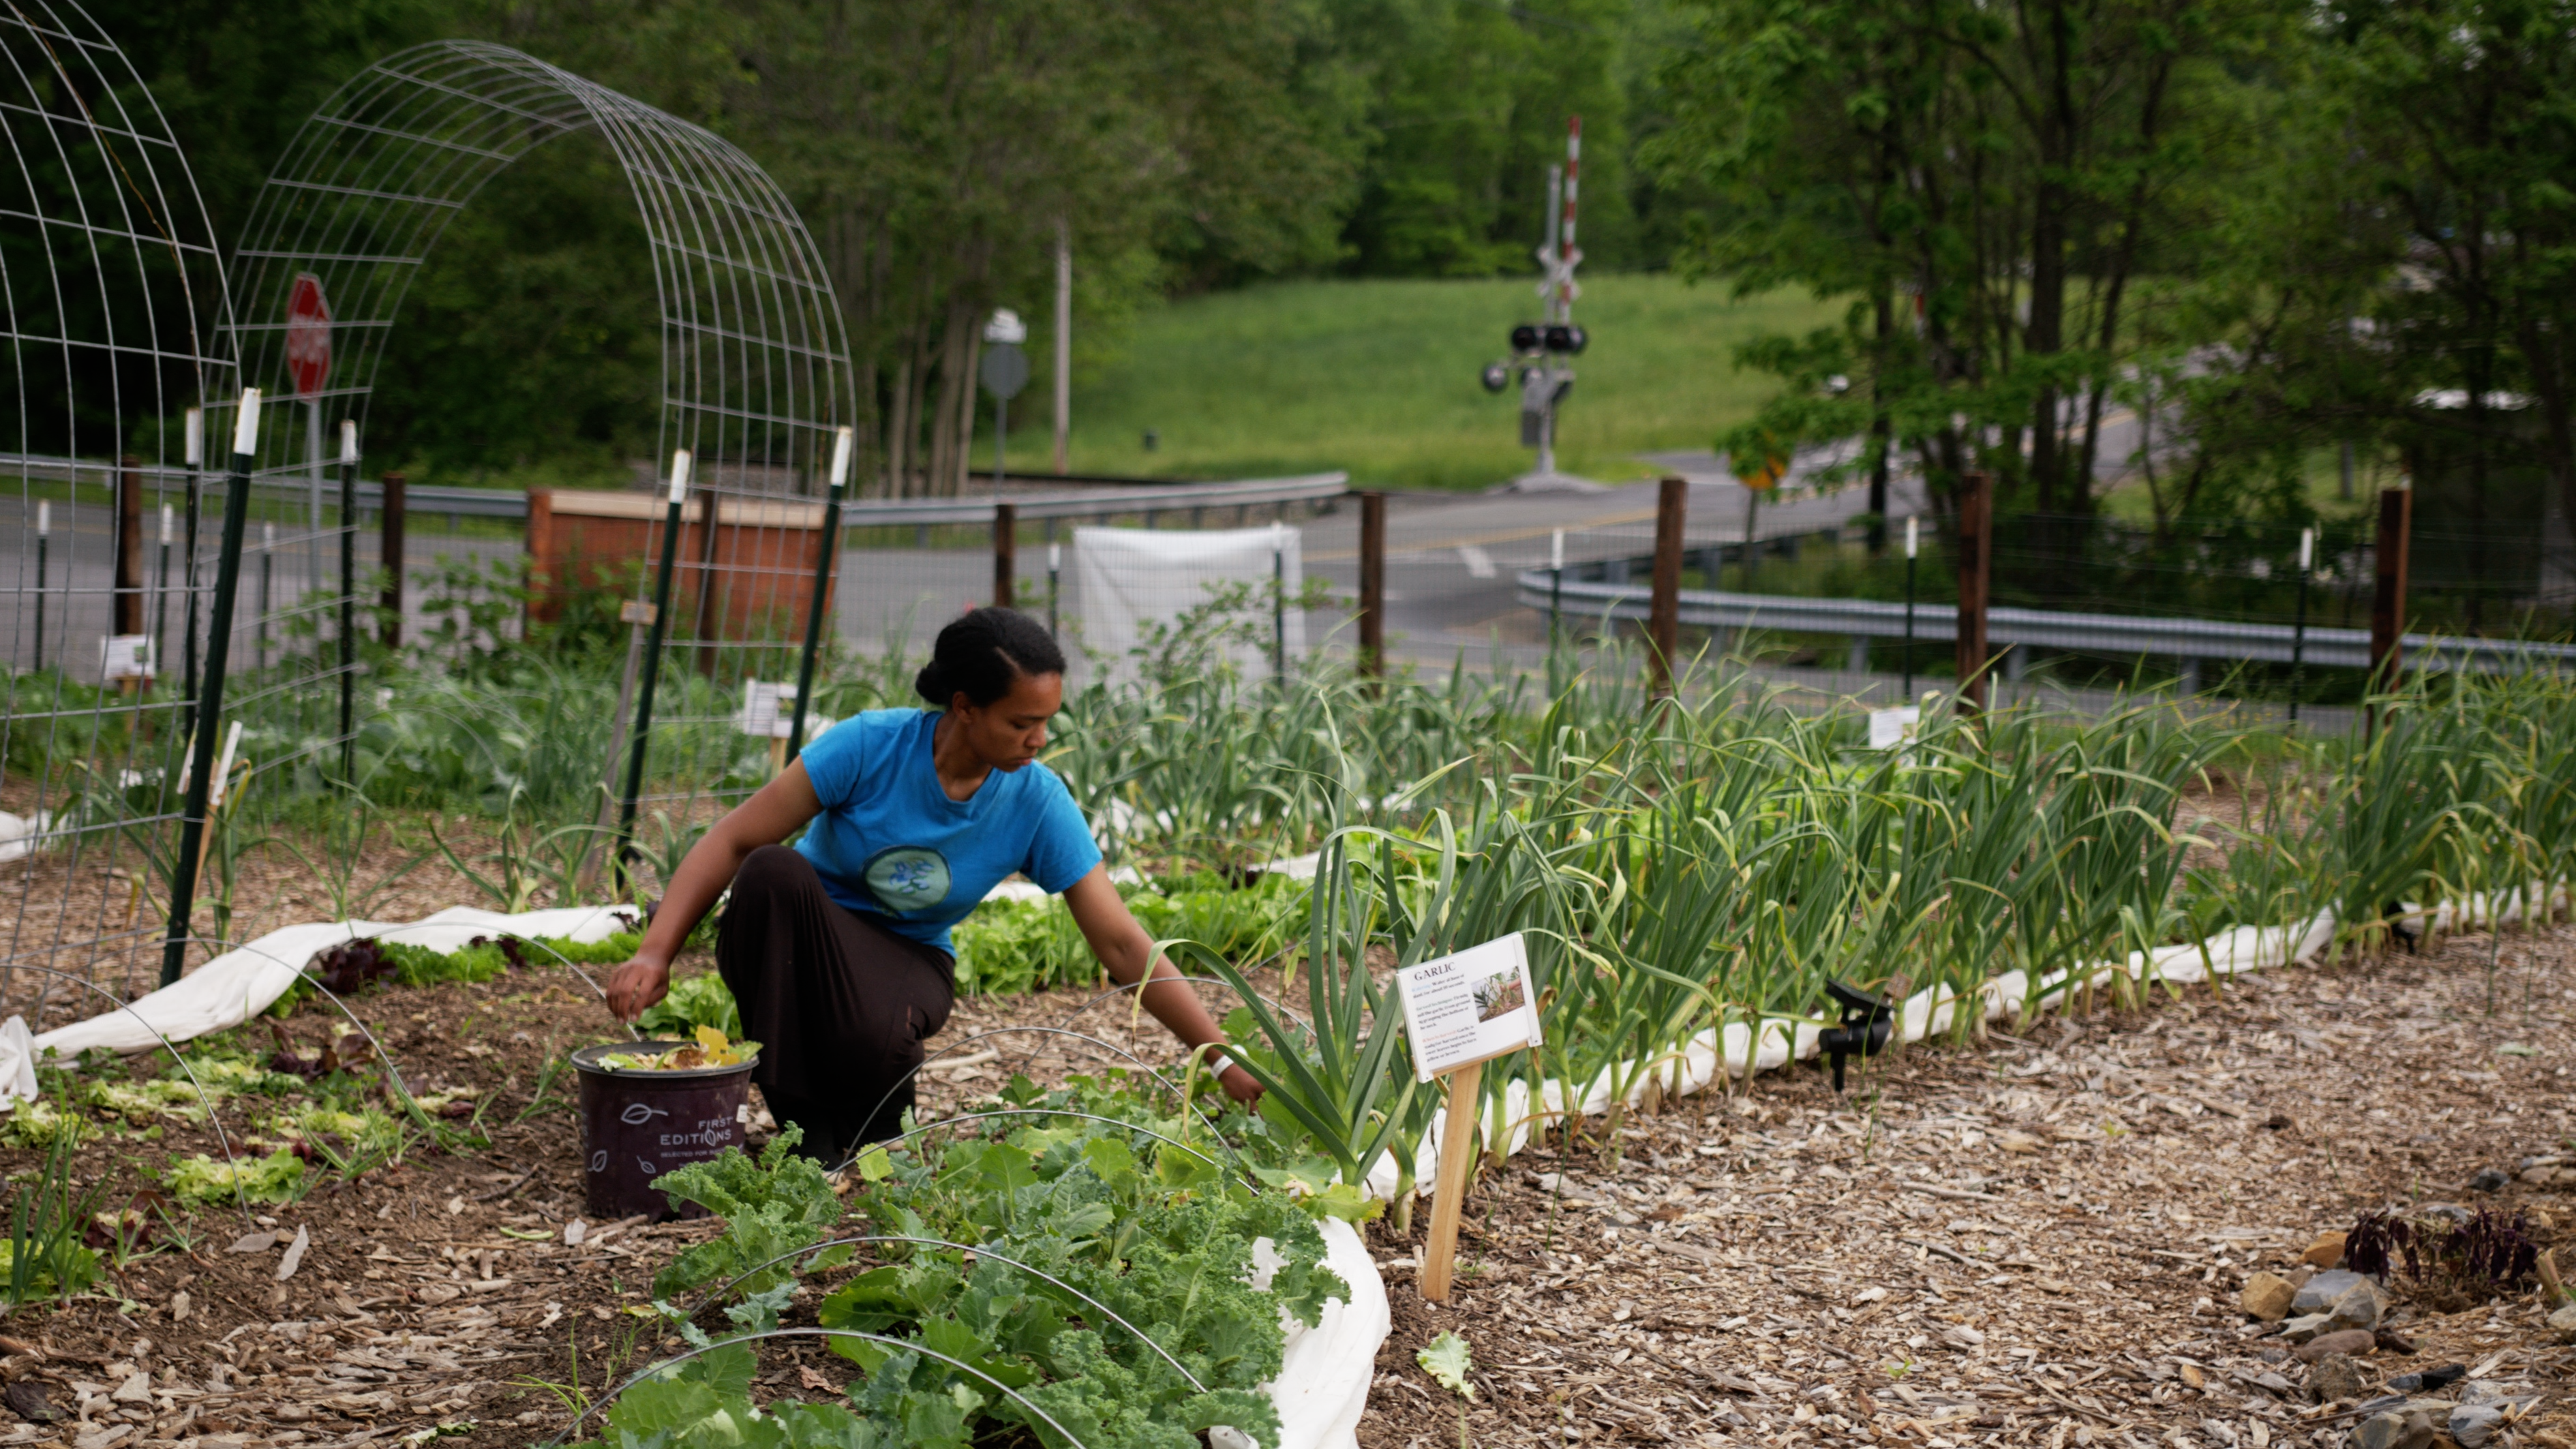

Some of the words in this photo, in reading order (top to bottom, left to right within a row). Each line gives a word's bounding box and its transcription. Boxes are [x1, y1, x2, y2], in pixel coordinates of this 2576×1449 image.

[1414, 962, 1456, 981] GARLIC
[1455, 999, 1471, 1008] ground
[1442, 1036, 1459, 1044] harvest
[698, 1116, 733, 1130] FIRST
[660, 1129, 731, 1146] EDITIONS
